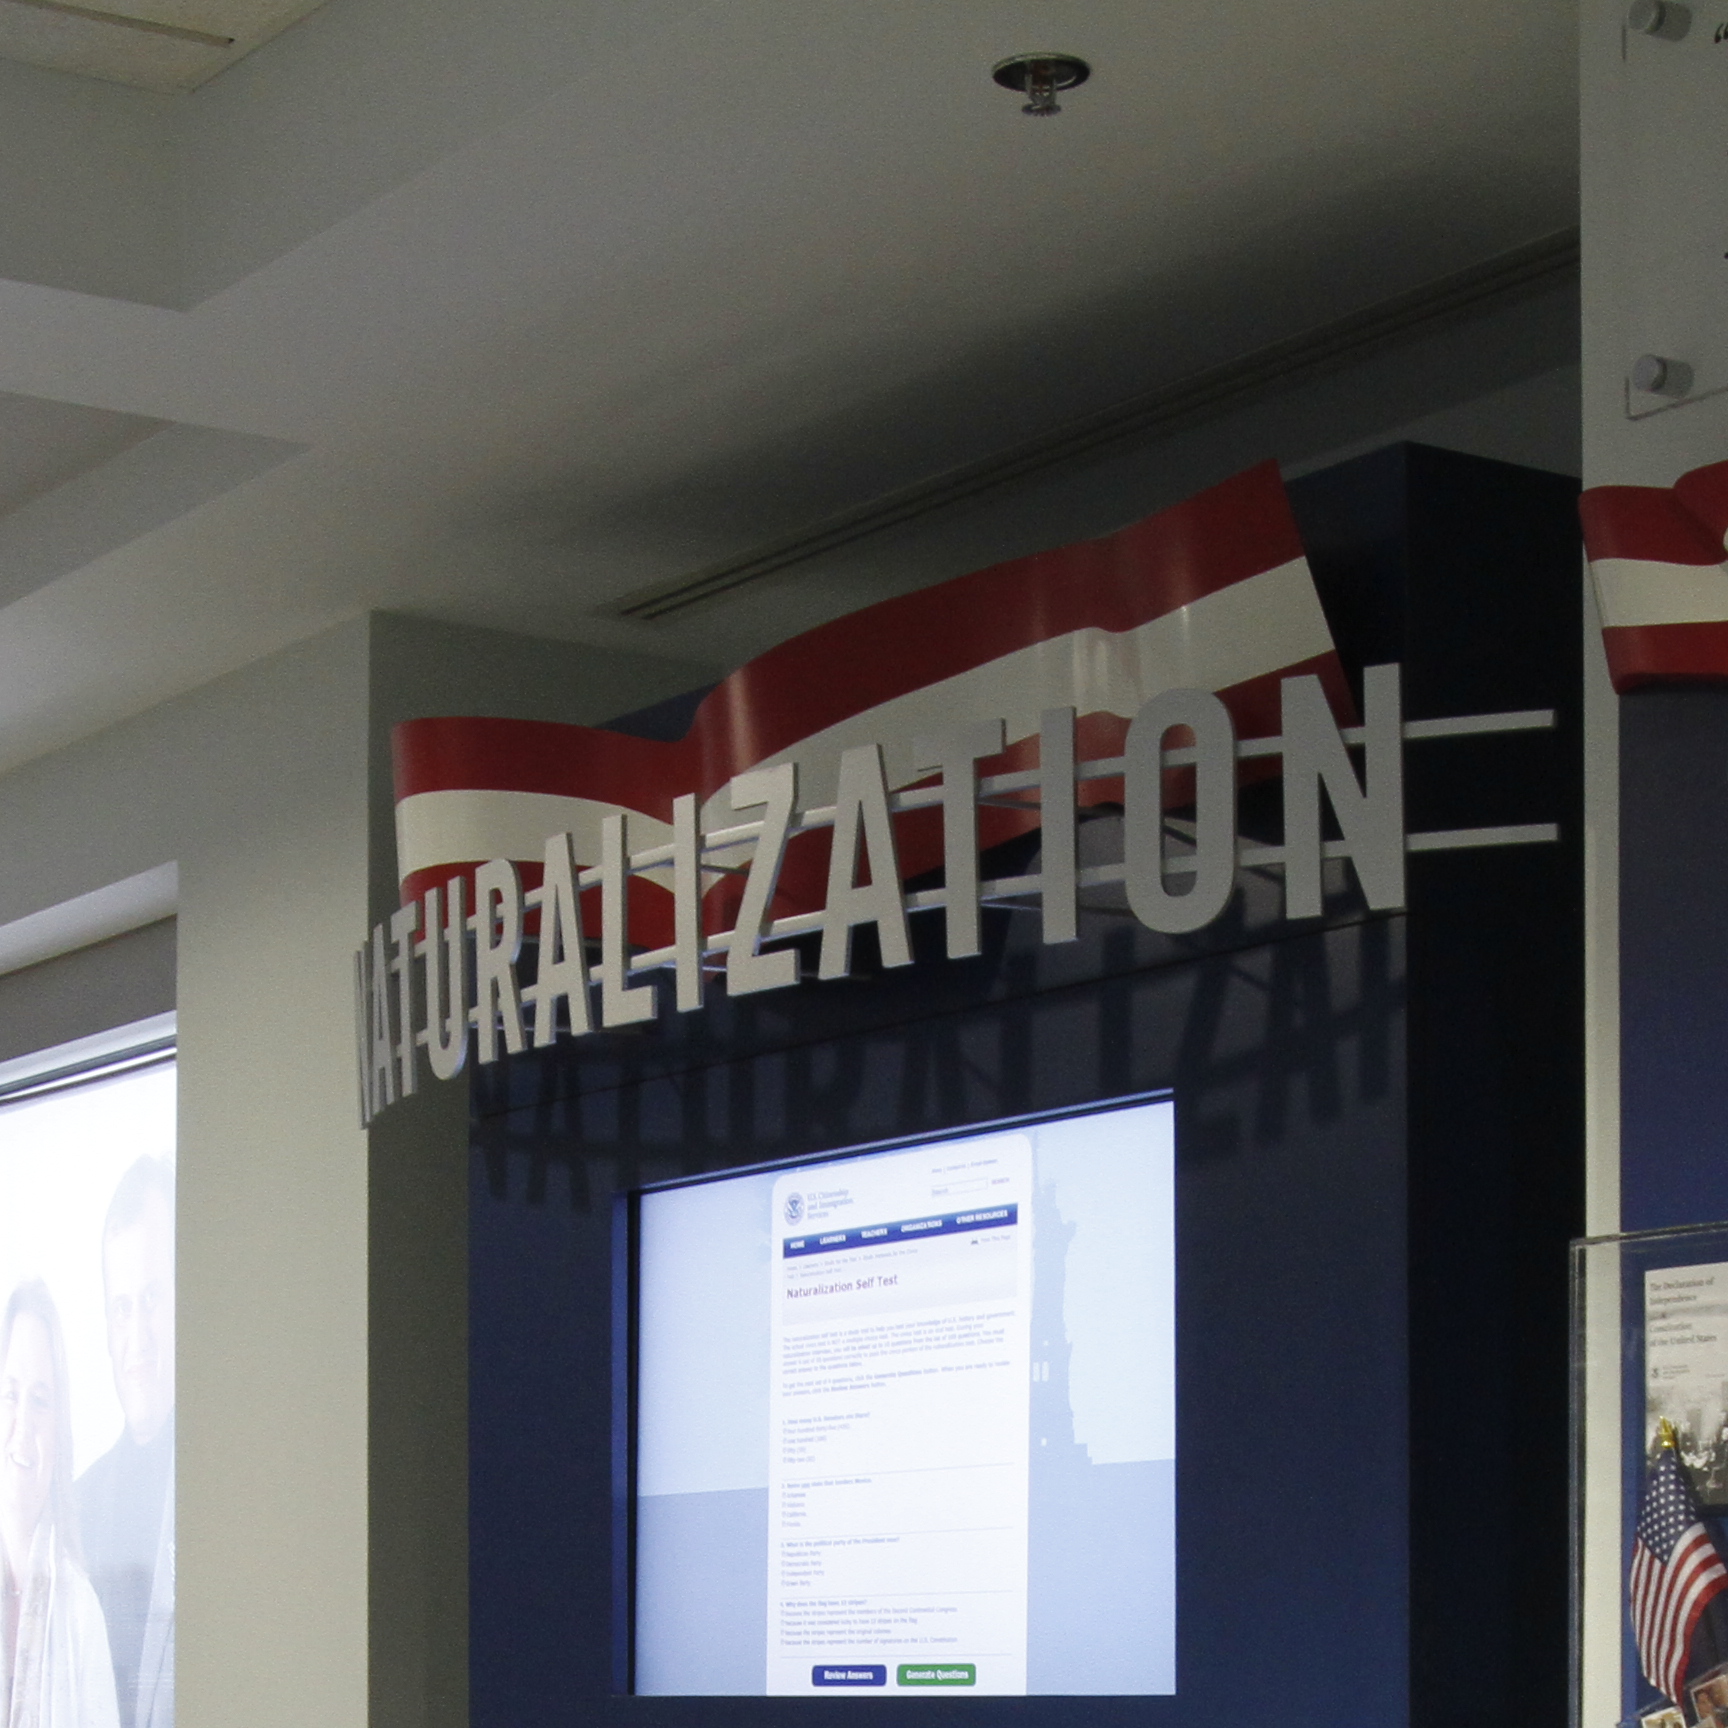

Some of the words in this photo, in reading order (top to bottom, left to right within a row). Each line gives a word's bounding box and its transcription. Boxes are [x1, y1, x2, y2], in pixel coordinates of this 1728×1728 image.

[353, 663, 1407, 1128] NATURALIZATION
[786, 1282, 853, 1299] Naturalization
[856, 1276, 875, 1290] Self
[877, 1274, 898, 1286] Test
[824, 1670, 846, 1680] Review
[847, 1670, 874, 1680] Answers
[936, 1669, 969, 1681] Questions
